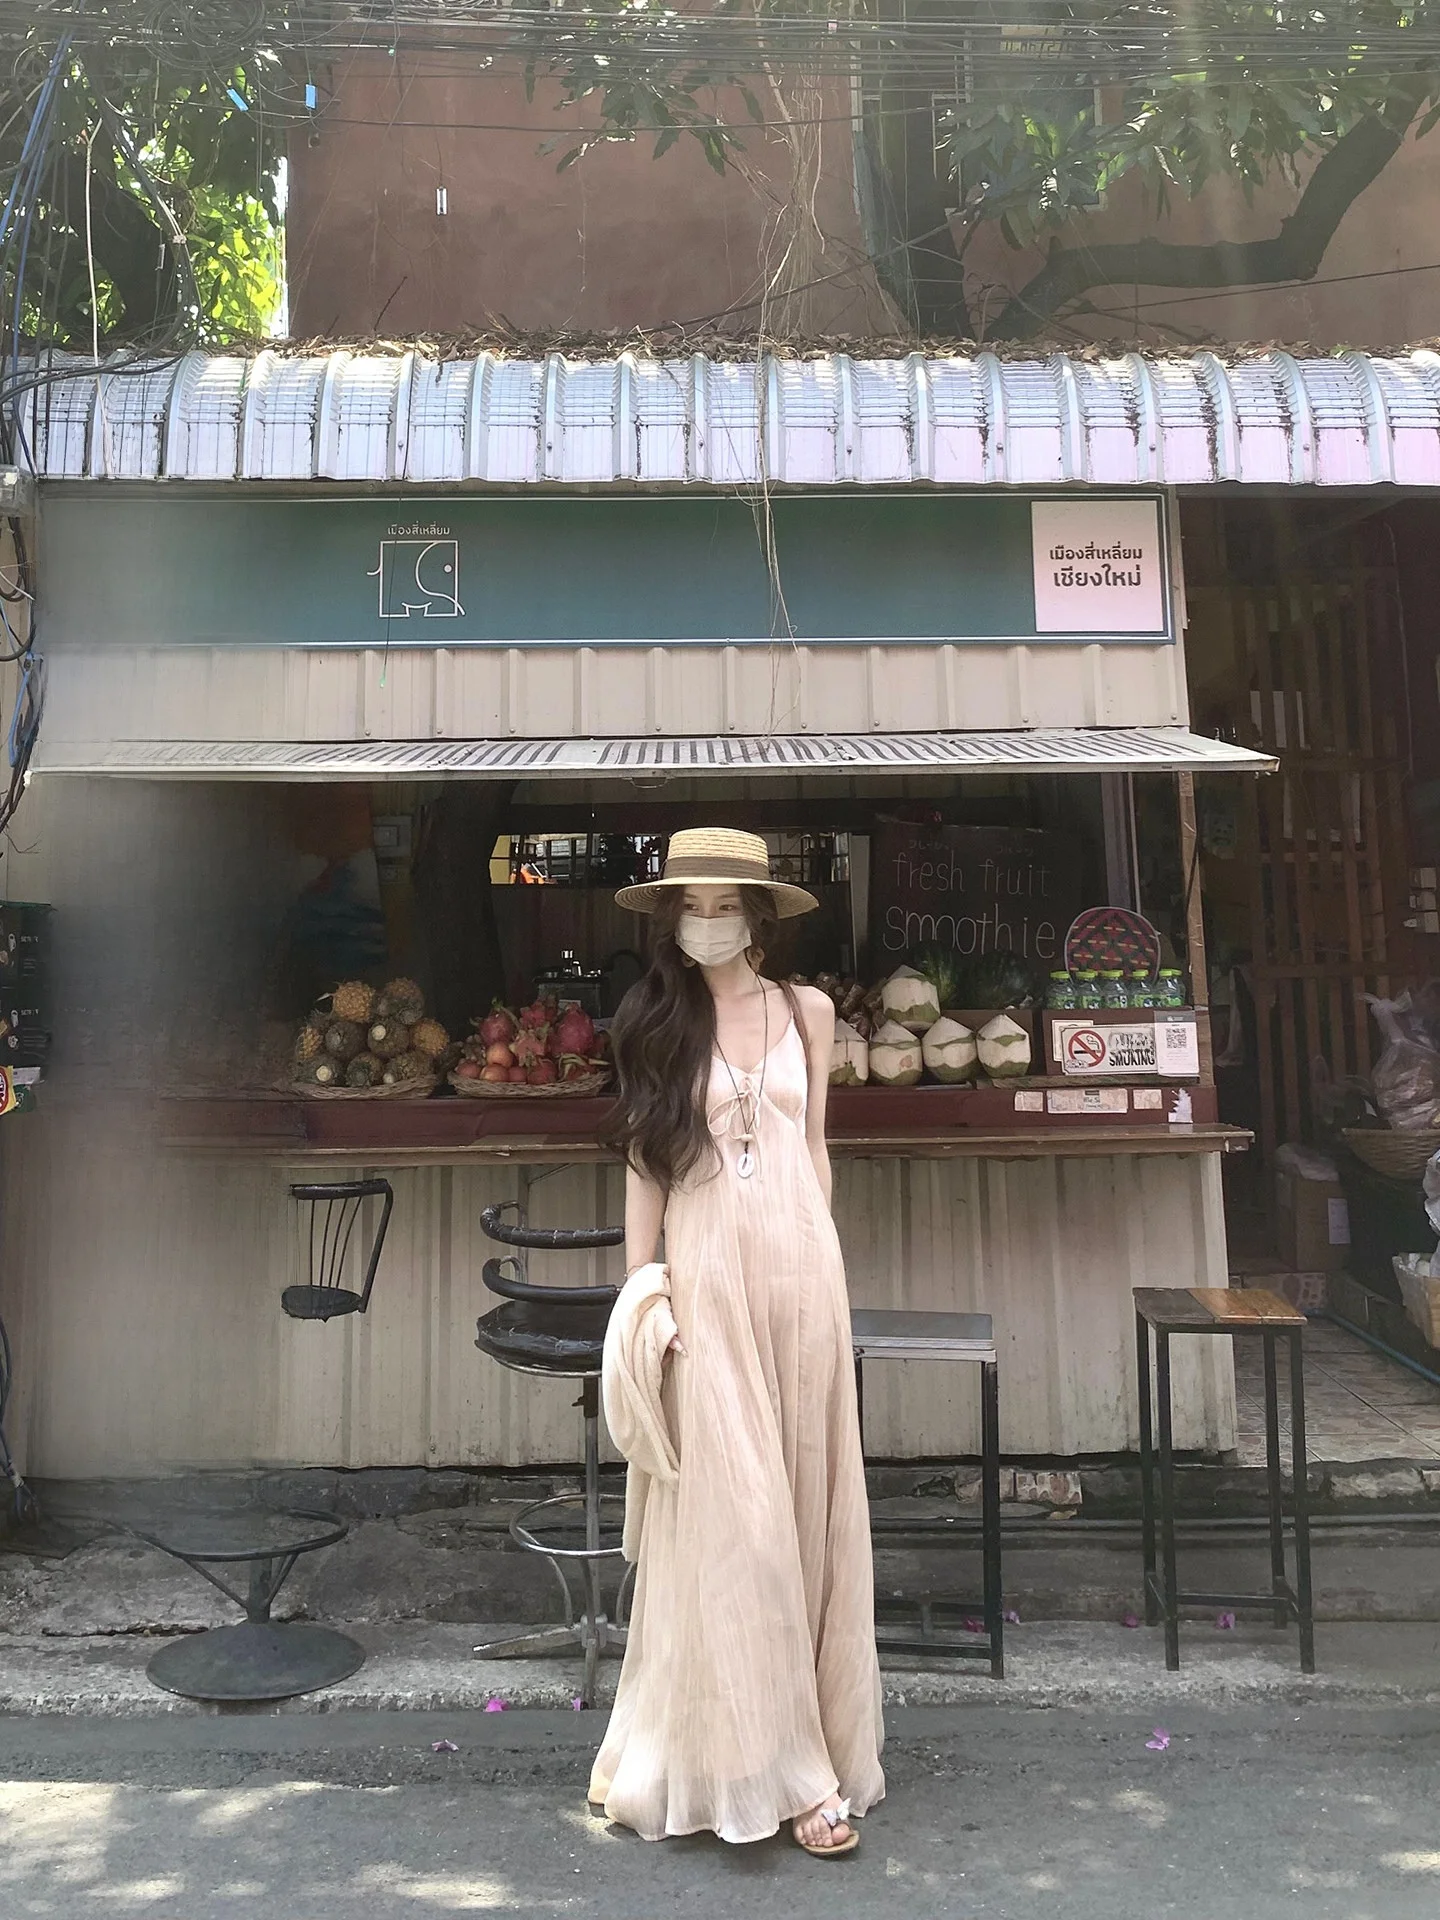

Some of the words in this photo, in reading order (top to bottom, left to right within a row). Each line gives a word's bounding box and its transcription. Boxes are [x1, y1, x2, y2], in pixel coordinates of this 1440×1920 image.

[387, 520, 450, 535] เมืองสี่เหลี่ยม
[1049, 541, 1143, 560] เมืองสี่เหลี่ยม
[1053, 563, 1142, 587] เชียงใหม่
[892, 850, 965, 892] fresh
[978, 858, 1051, 897] fruit
